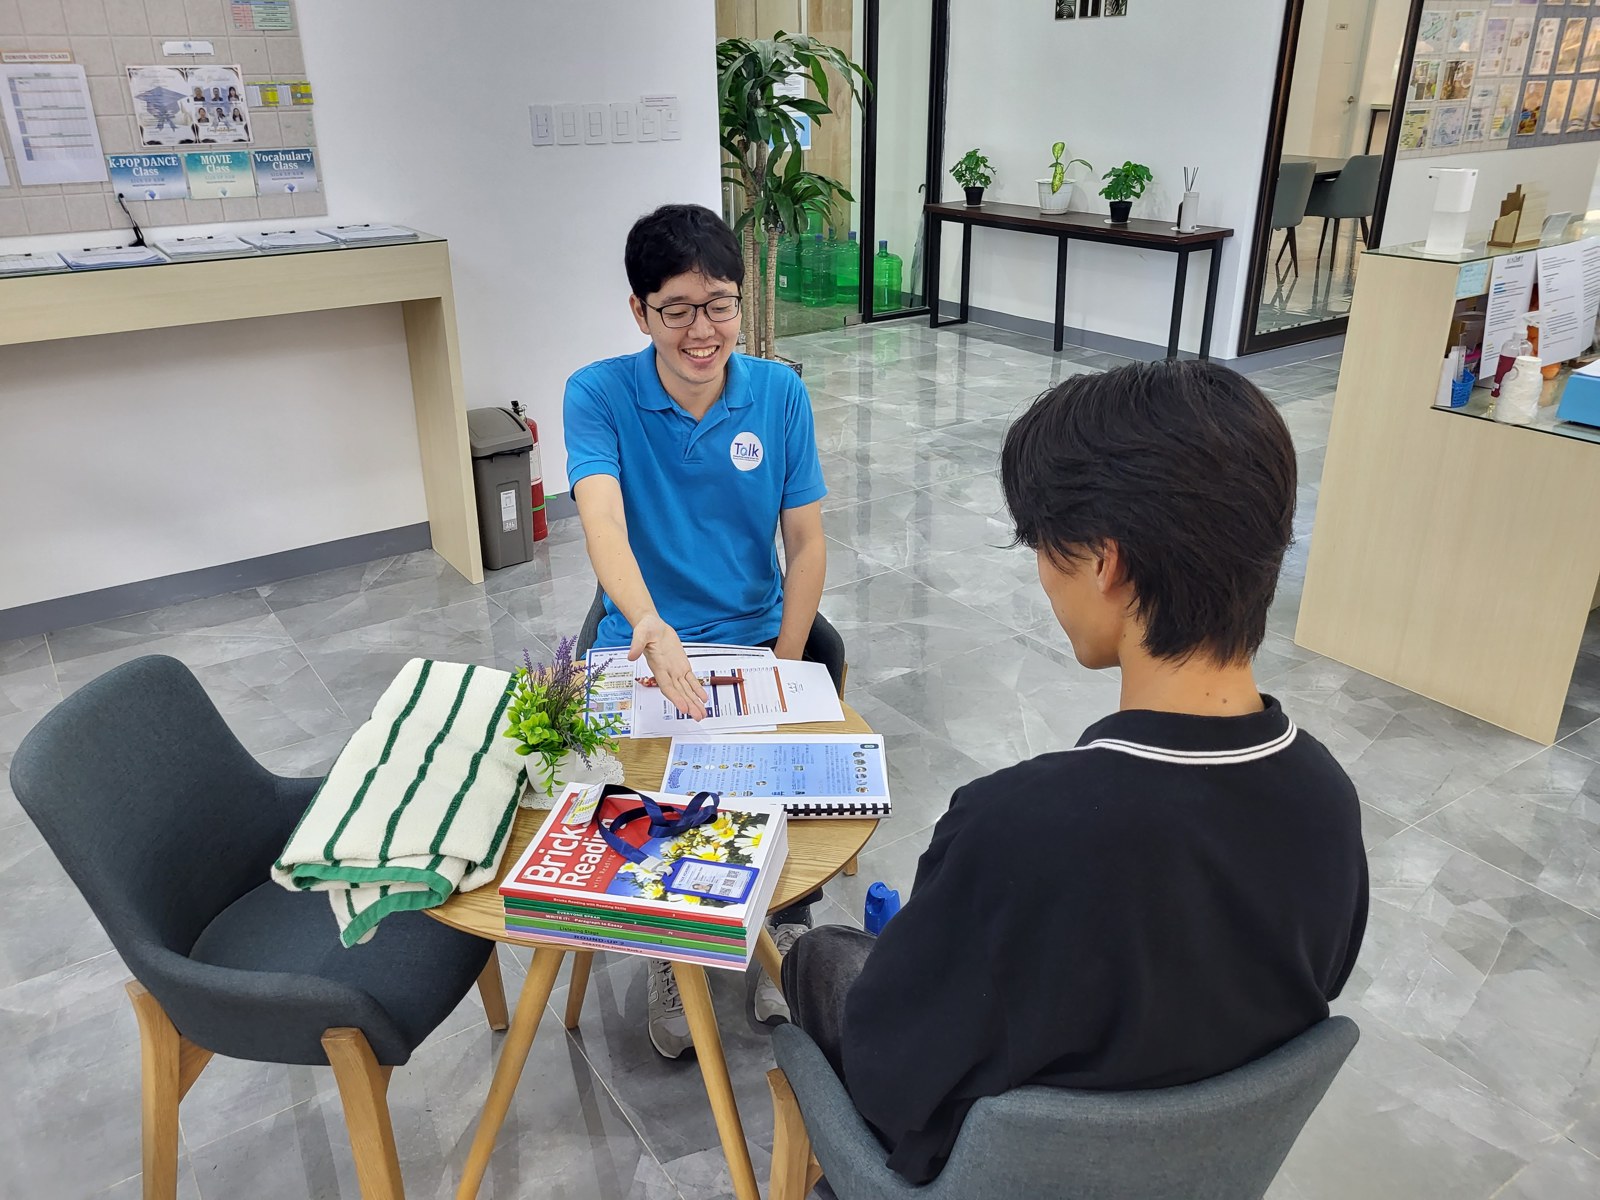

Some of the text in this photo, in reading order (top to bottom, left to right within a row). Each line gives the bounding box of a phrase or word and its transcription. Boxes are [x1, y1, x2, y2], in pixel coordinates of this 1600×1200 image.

[109, 156, 178, 168] K-POP DANCE
[200, 155, 232, 165] MOVIE
[255, 151, 312, 163] Vocabulary
[206, 163, 230, 174] Class
[272, 161, 298, 170] Class
[132, 167, 159, 177] Class
[560, 926, 583, 934] Listening
[574, 935, 618, 944] ROUND-UP
